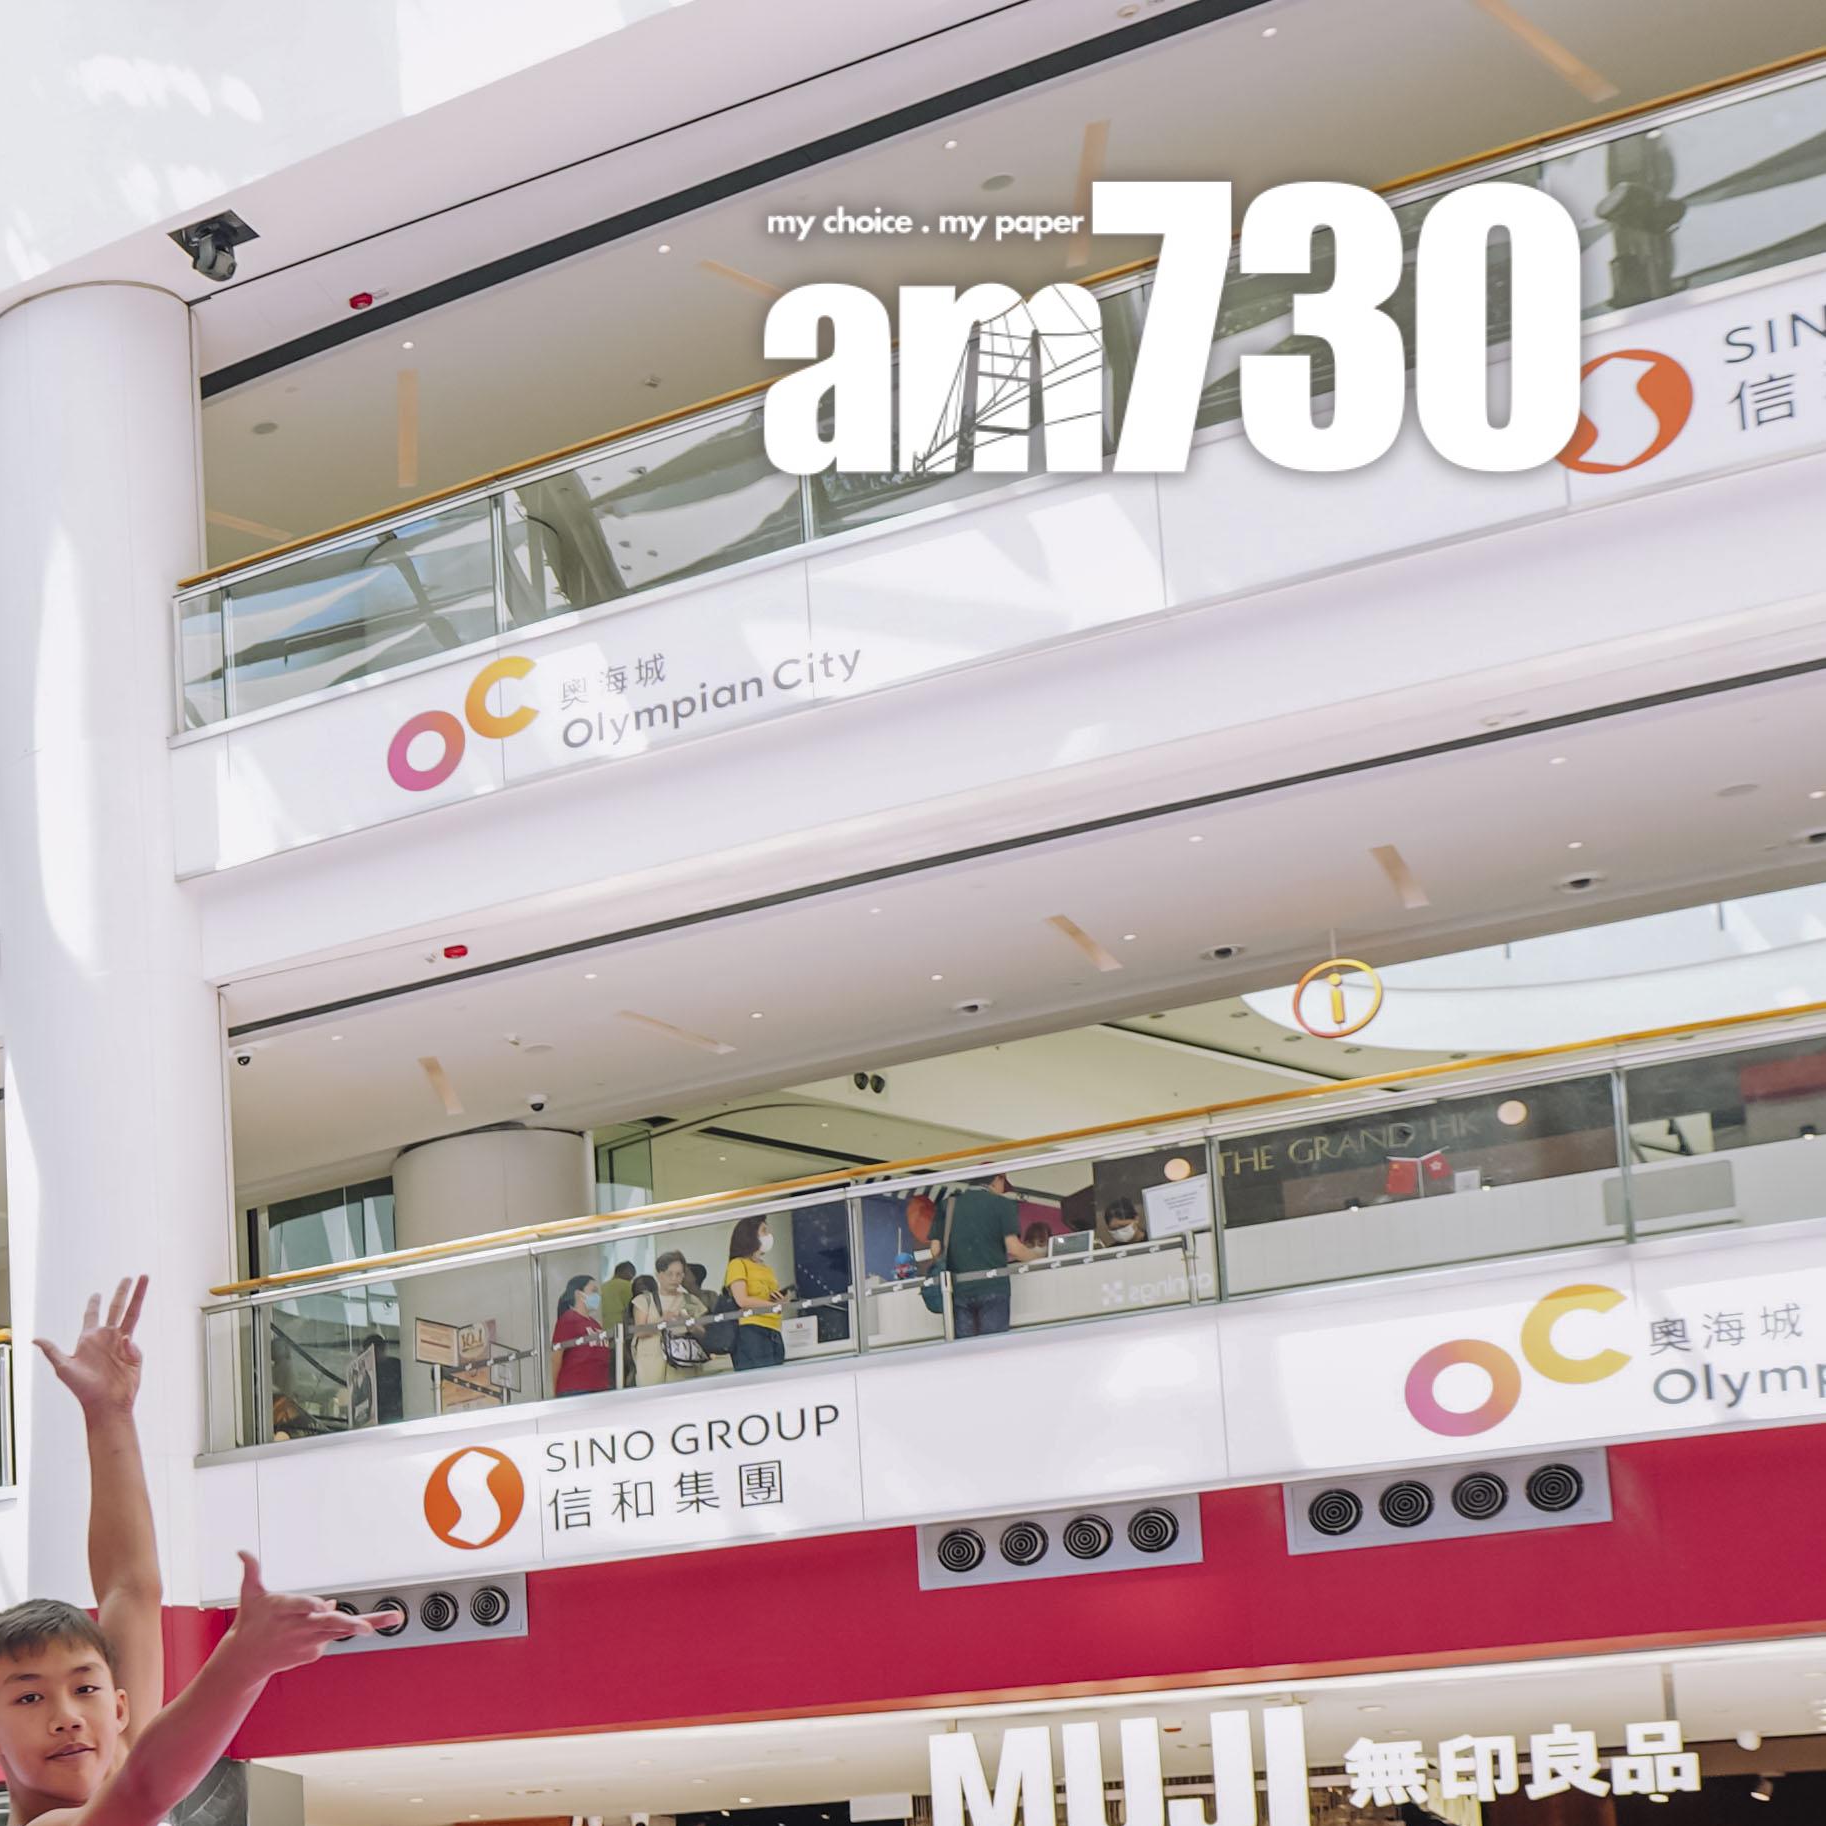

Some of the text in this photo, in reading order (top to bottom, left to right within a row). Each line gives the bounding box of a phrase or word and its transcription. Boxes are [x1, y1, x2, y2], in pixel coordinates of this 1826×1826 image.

[562, 648, 862, 749] Olympian City
[1287, 1122, 1415, 1165] GRAND
[1649, 1302, 1804, 1356] 奧海城
[546, 1404, 839, 1473] SINO GROUP
[548, 1460, 784, 1532] 信和集團
[1343, 1720, 1702, 1810] 無印良品
